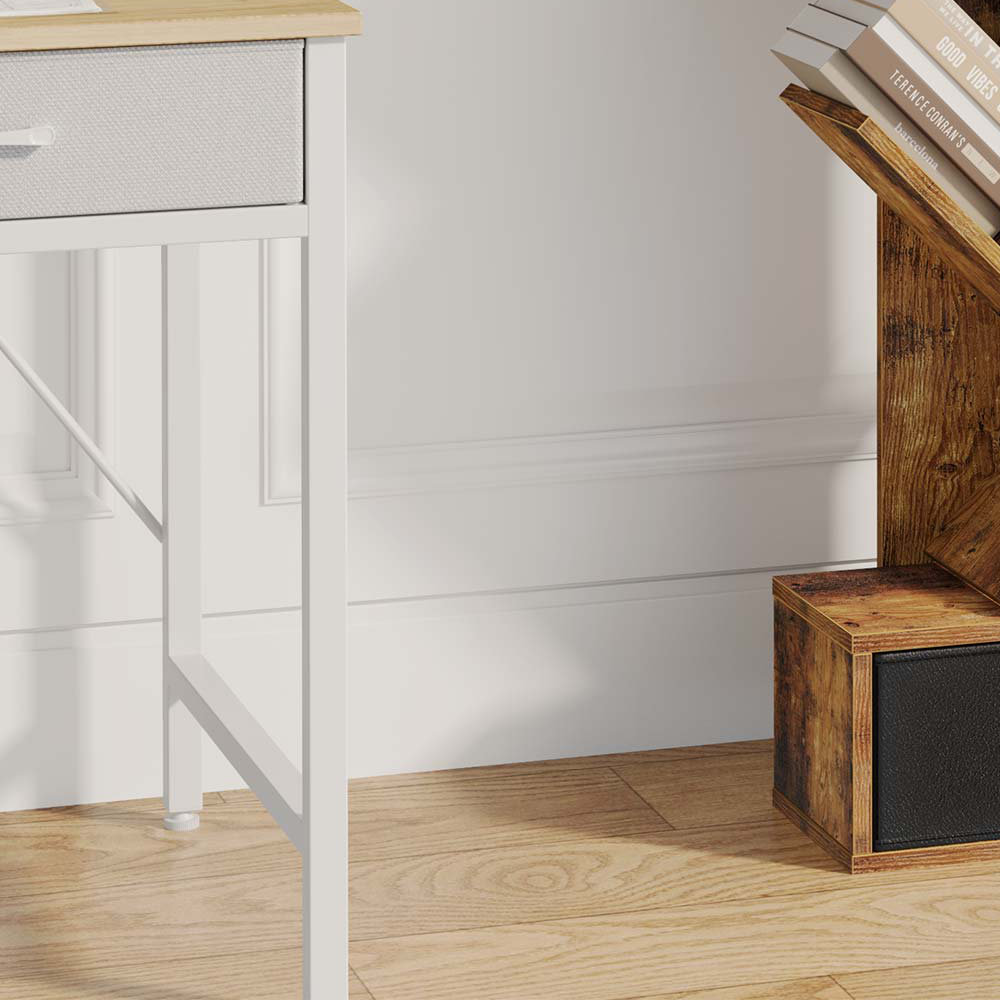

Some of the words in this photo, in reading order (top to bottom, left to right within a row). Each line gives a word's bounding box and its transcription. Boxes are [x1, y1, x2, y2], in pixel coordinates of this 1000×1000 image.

[962, 25, 984, 48] IN
[933, 34, 967, 69] GOOD
[963, 64, 1000, 101] VIBES
[887, 68, 931, 113] TERENCE
[924, 105, 967, 149] CONRAN'S
[892, 121, 942, 172] barcelona
